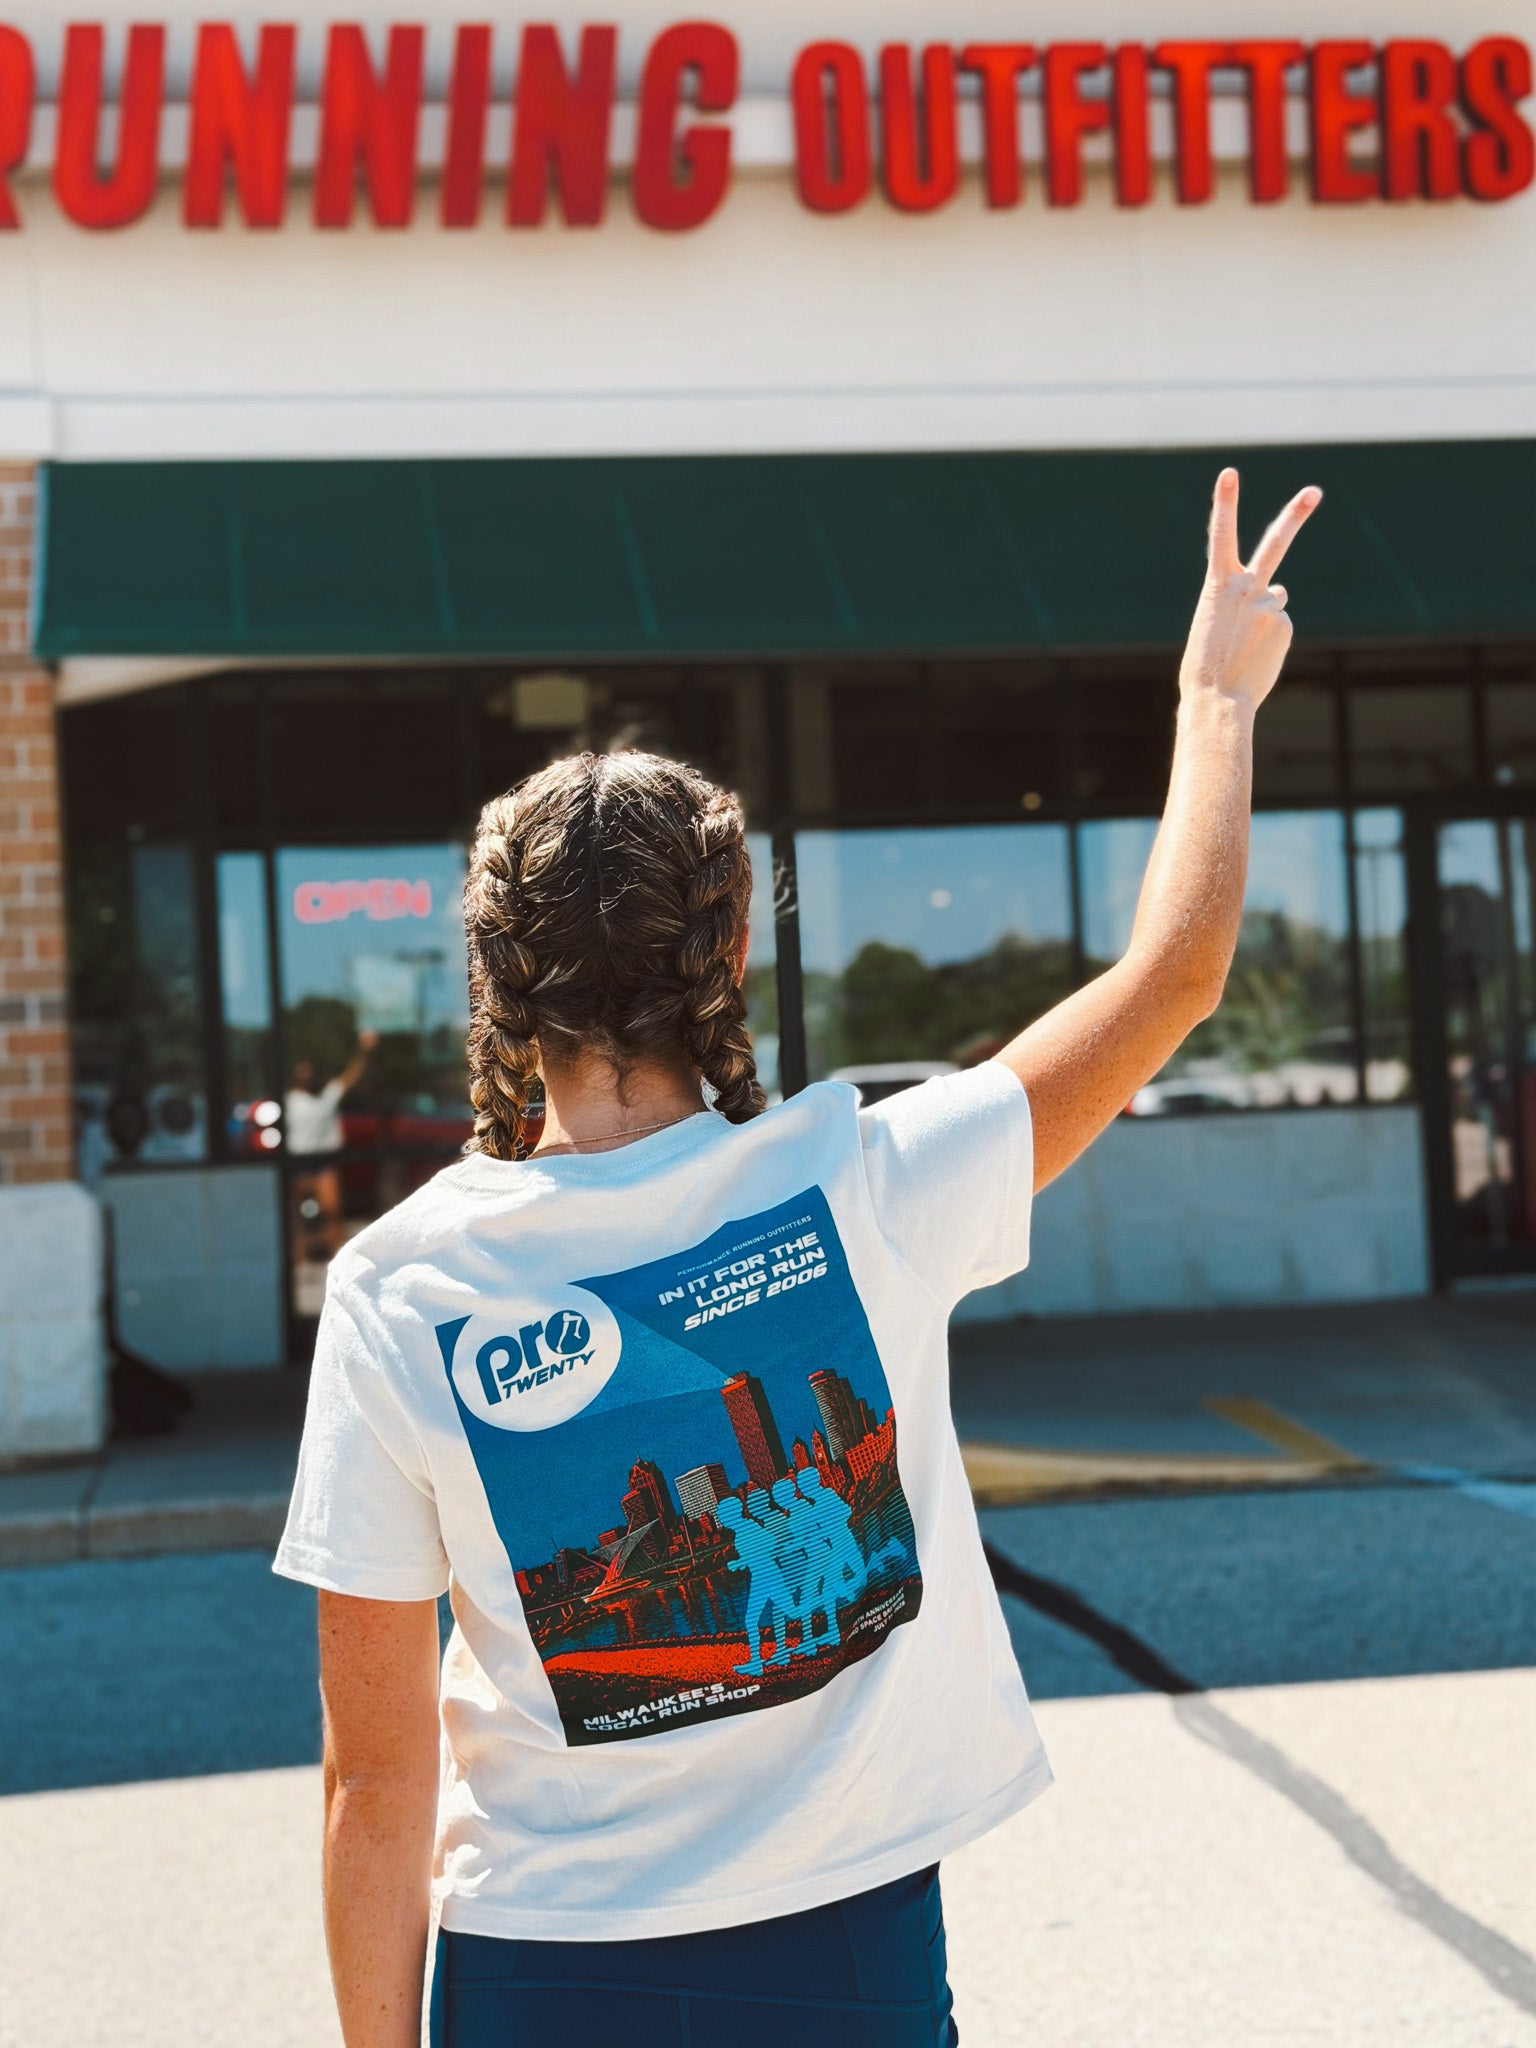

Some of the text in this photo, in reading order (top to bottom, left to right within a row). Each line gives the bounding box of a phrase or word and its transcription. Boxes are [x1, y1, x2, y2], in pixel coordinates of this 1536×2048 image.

[789, 34, 1536, 213] OUTFITTERS
[294, 879, 432, 924] OPEN
[658, 1231, 820, 1306] IN IT FOR THE
[677, 1214, 813, 1277] PERFORMANCE RUNNING OUTFITTERS
[684, 1262, 828, 1332] SINCE 2006
[696, 1247, 826, 1309] LONG RUN
[502, 1349, 596, 1399] TWENTY
[860, 1613, 882, 1630] SPACE
[873, 1619, 888, 1633] JULY
[583, 1682, 725, 1726] MILWAUKEE'S
[586, 1684, 761, 1731] LOCAL RUN SHOP
